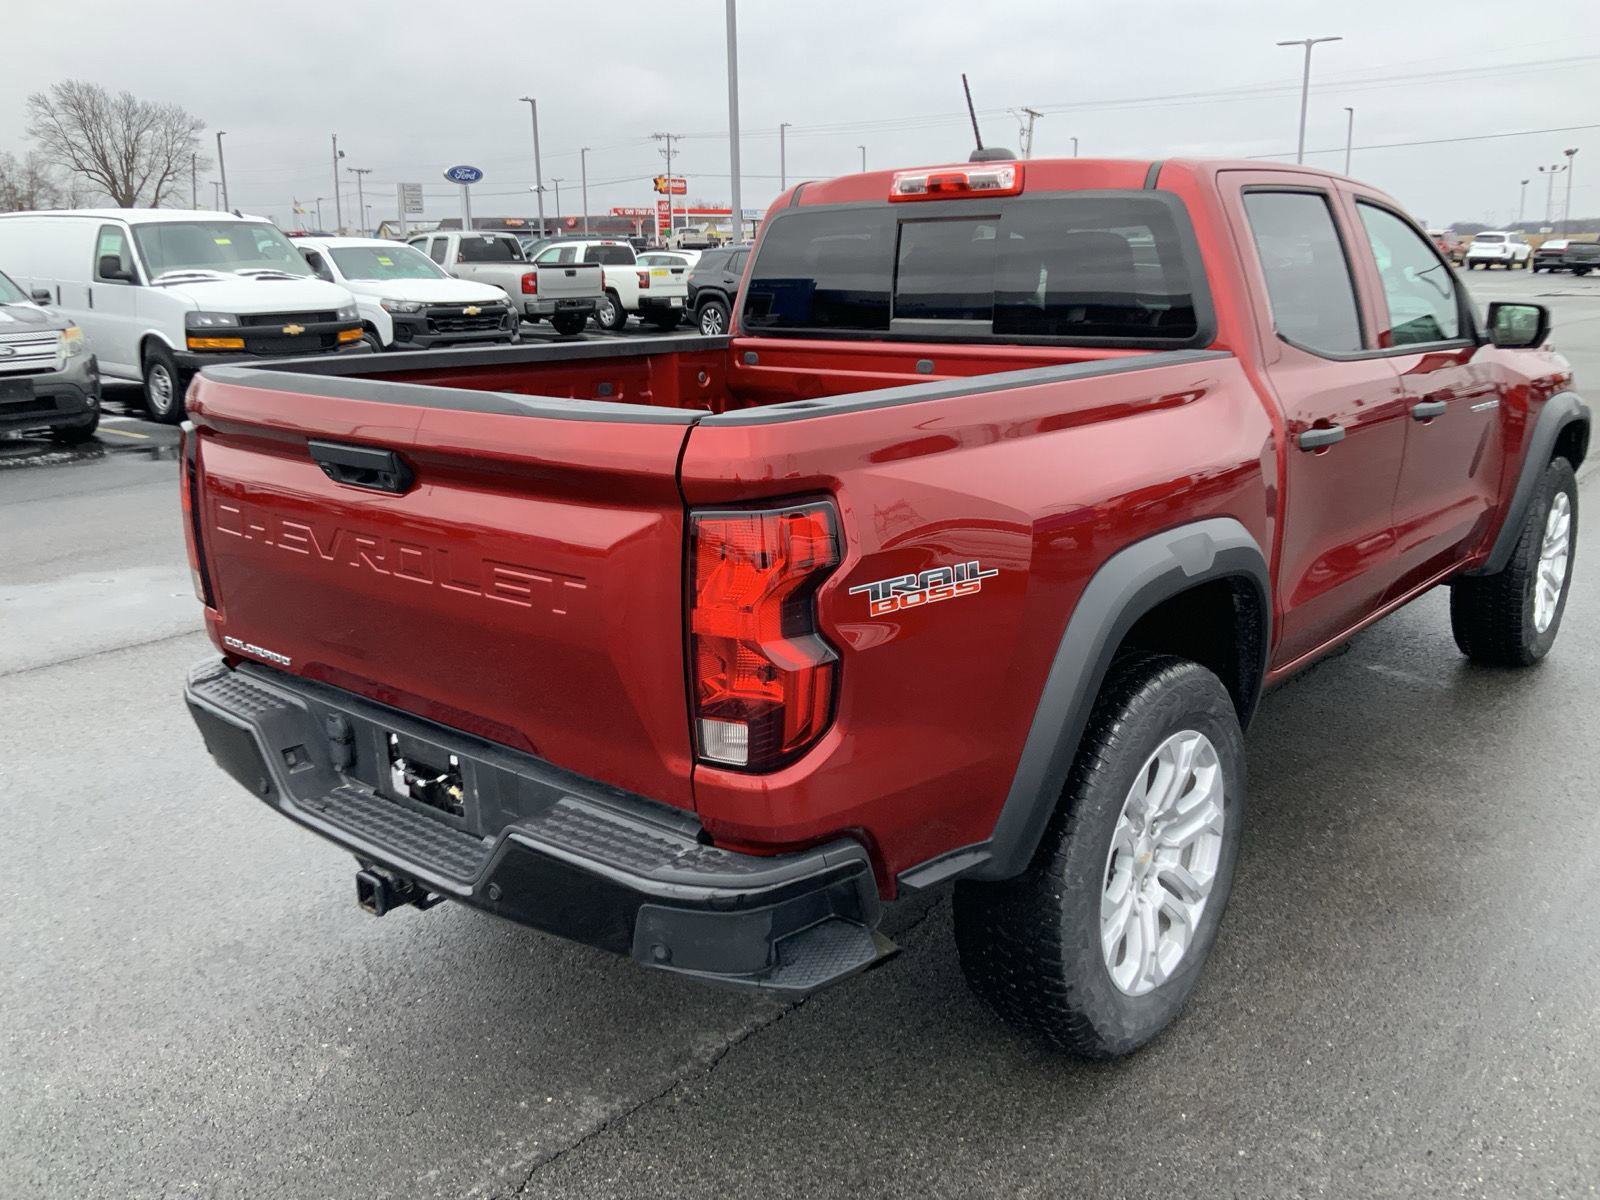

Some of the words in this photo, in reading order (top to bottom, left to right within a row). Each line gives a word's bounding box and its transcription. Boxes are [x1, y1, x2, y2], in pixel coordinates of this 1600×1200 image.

[454, 168, 477, 181] Ford
[624, 207, 634, 216] ON
[216, 504, 587, 615] CHEVROLET
[849, 560, 999, 602] TRAIL
[870, 579, 981, 618] BOSS
[224, 635, 292, 666] COLORADO
